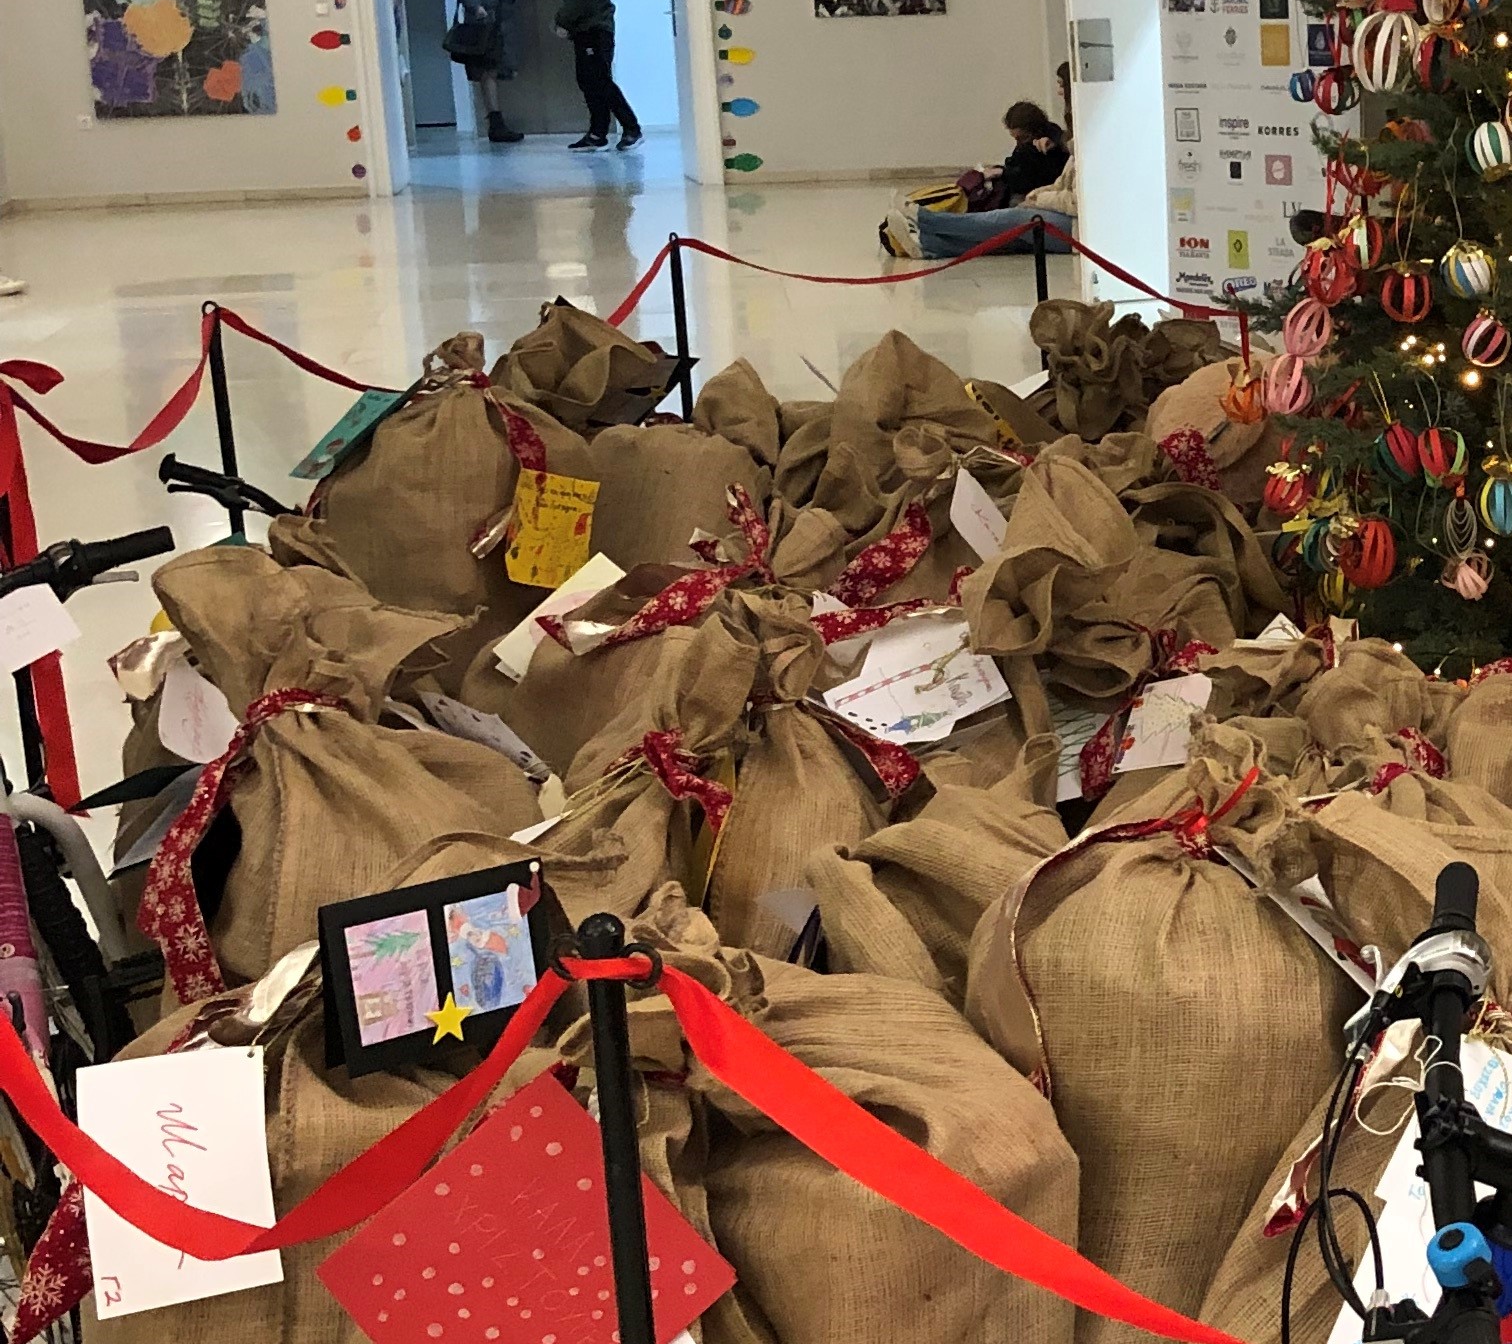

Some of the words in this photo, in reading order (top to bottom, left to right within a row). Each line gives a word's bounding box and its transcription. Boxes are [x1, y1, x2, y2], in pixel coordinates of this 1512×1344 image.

[1219, 116, 1250, 131] inspire
[1258, 126, 1300, 137] KORRES
[1179, 237, 1210, 249] ION
